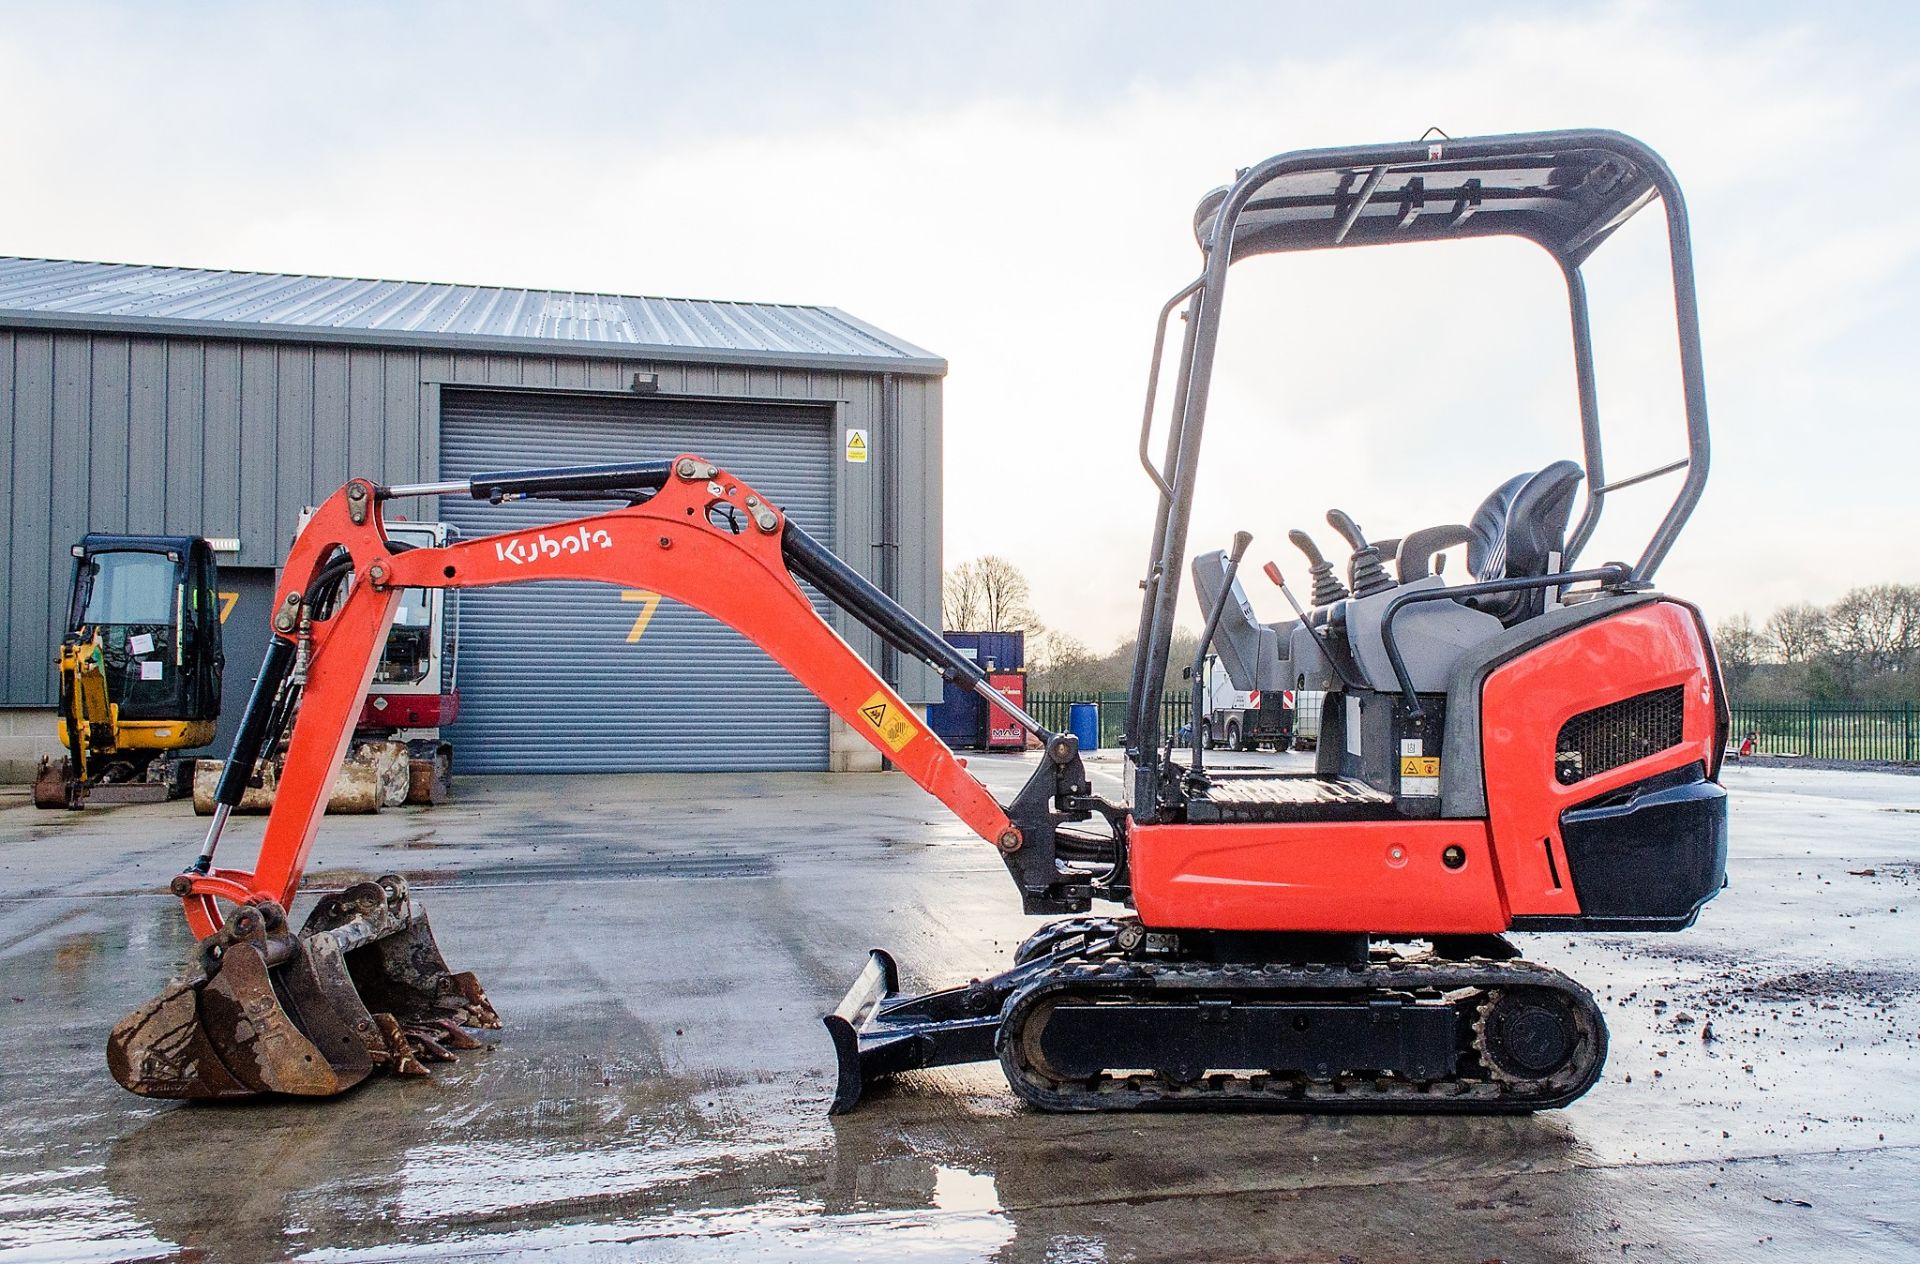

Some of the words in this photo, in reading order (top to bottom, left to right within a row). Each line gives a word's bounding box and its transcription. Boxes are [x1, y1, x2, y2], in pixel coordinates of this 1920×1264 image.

[495, 526, 613, 564] Kubota
[218, 592, 239, 624] 7
[621, 590, 662, 643] 7
